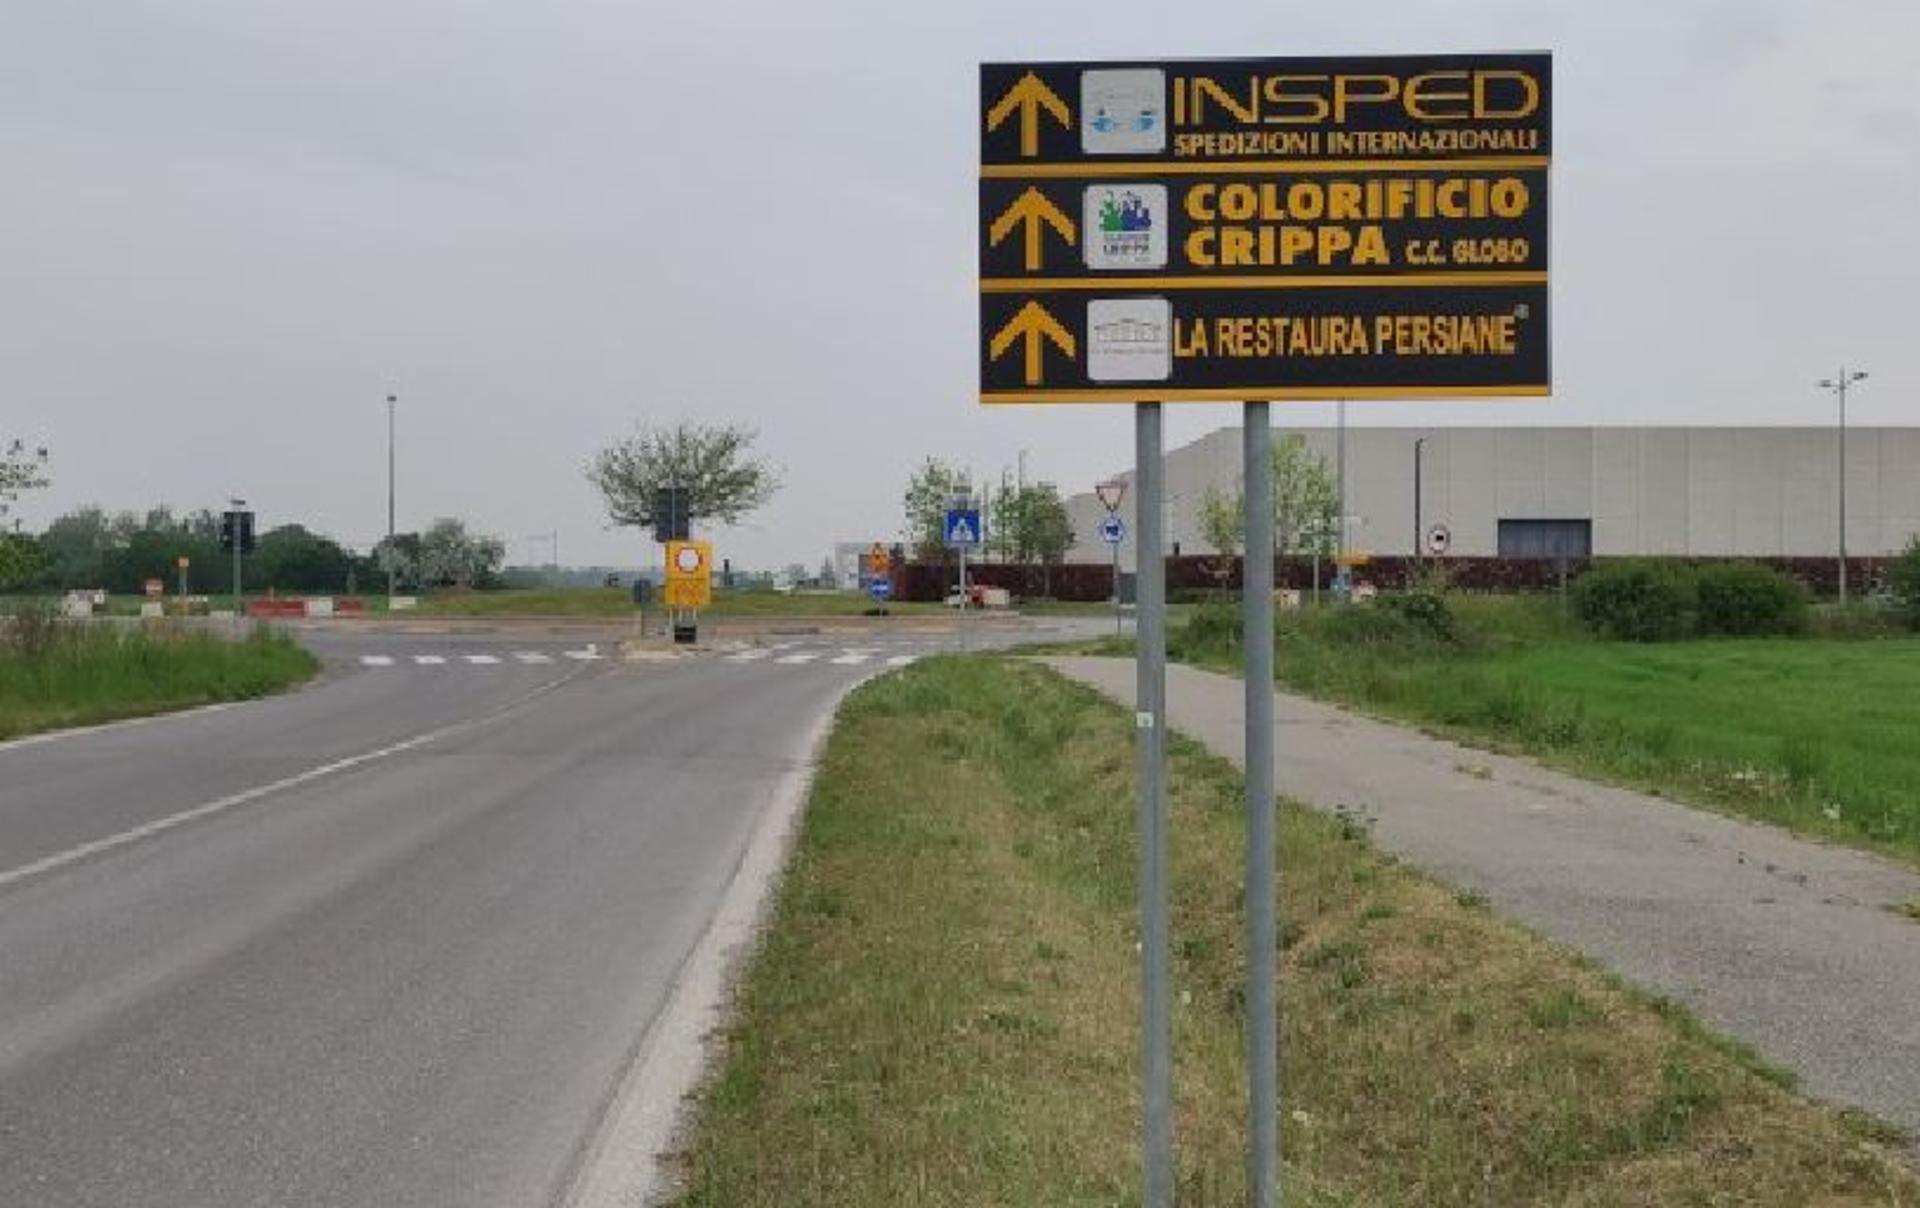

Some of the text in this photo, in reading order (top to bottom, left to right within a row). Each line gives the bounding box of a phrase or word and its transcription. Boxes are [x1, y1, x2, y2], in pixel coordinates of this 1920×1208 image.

[1174, 70, 1539, 125] INSPED
[1174, 129, 1537, 156] SPEDIZIONI INTERNAZIONALI
[1186, 177, 1529, 220] COLORIFICIO
[1186, 226, 1390, 265] CRIPPA
[1453, 238, 1529, 264] GLOBO
[1174, 317, 1208, 357] LA
[1216, 315, 1369, 357] RESTAURA
